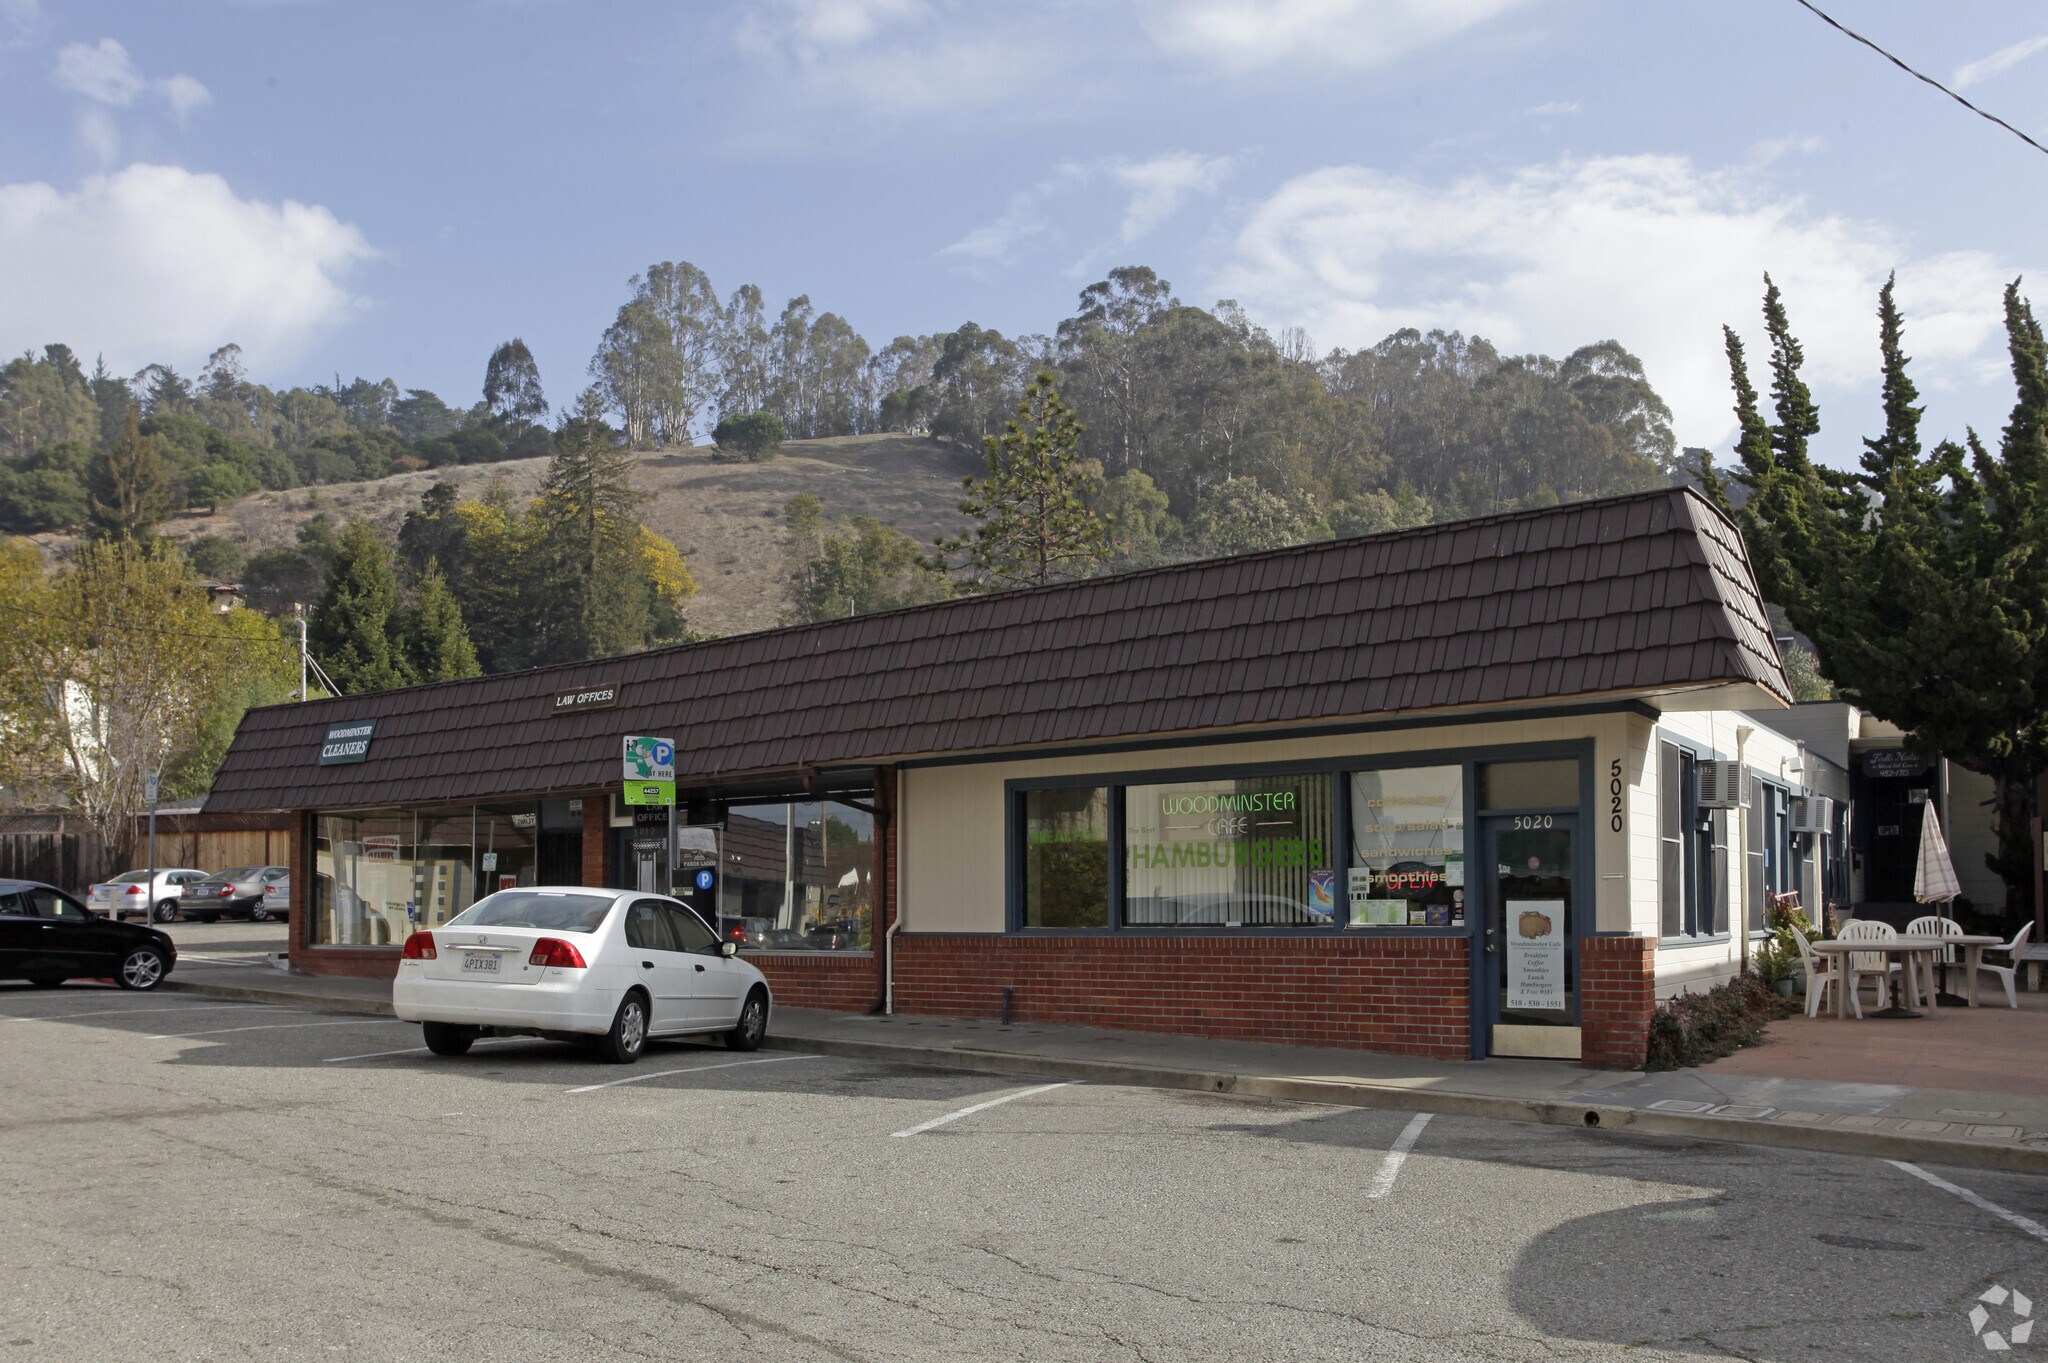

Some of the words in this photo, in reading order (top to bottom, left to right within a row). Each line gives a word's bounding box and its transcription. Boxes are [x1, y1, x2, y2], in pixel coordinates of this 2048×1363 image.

[556, 694, 575, 707] LAW
[577, 689, 614, 704] OFFICES
[328, 725, 372, 740] WOODMINSTER
[322, 740, 368, 758] CLEANERS
[656, 745, 670, 763] P
[658, 770, 672, 778] HERE
[1162, 792, 1295, 815] WOODMINSTER
[1610, 758, 1622, 833] 5020
[1207, 817, 1248, 836] CAFE
[1364, 820, 1449, 833] soup/salad
[1514, 815, 1553, 830] 5020
[1132, 838, 1324, 869] HAMBURGERS
[1360, 846, 1453, 858] sandwiches
[701, 873, 709, 887] P
[1366, 870, 1449, 883] smoothies
[1386, 871, 1435, 890] OPEN
[464, 959, 497, 970] 4PIX381
